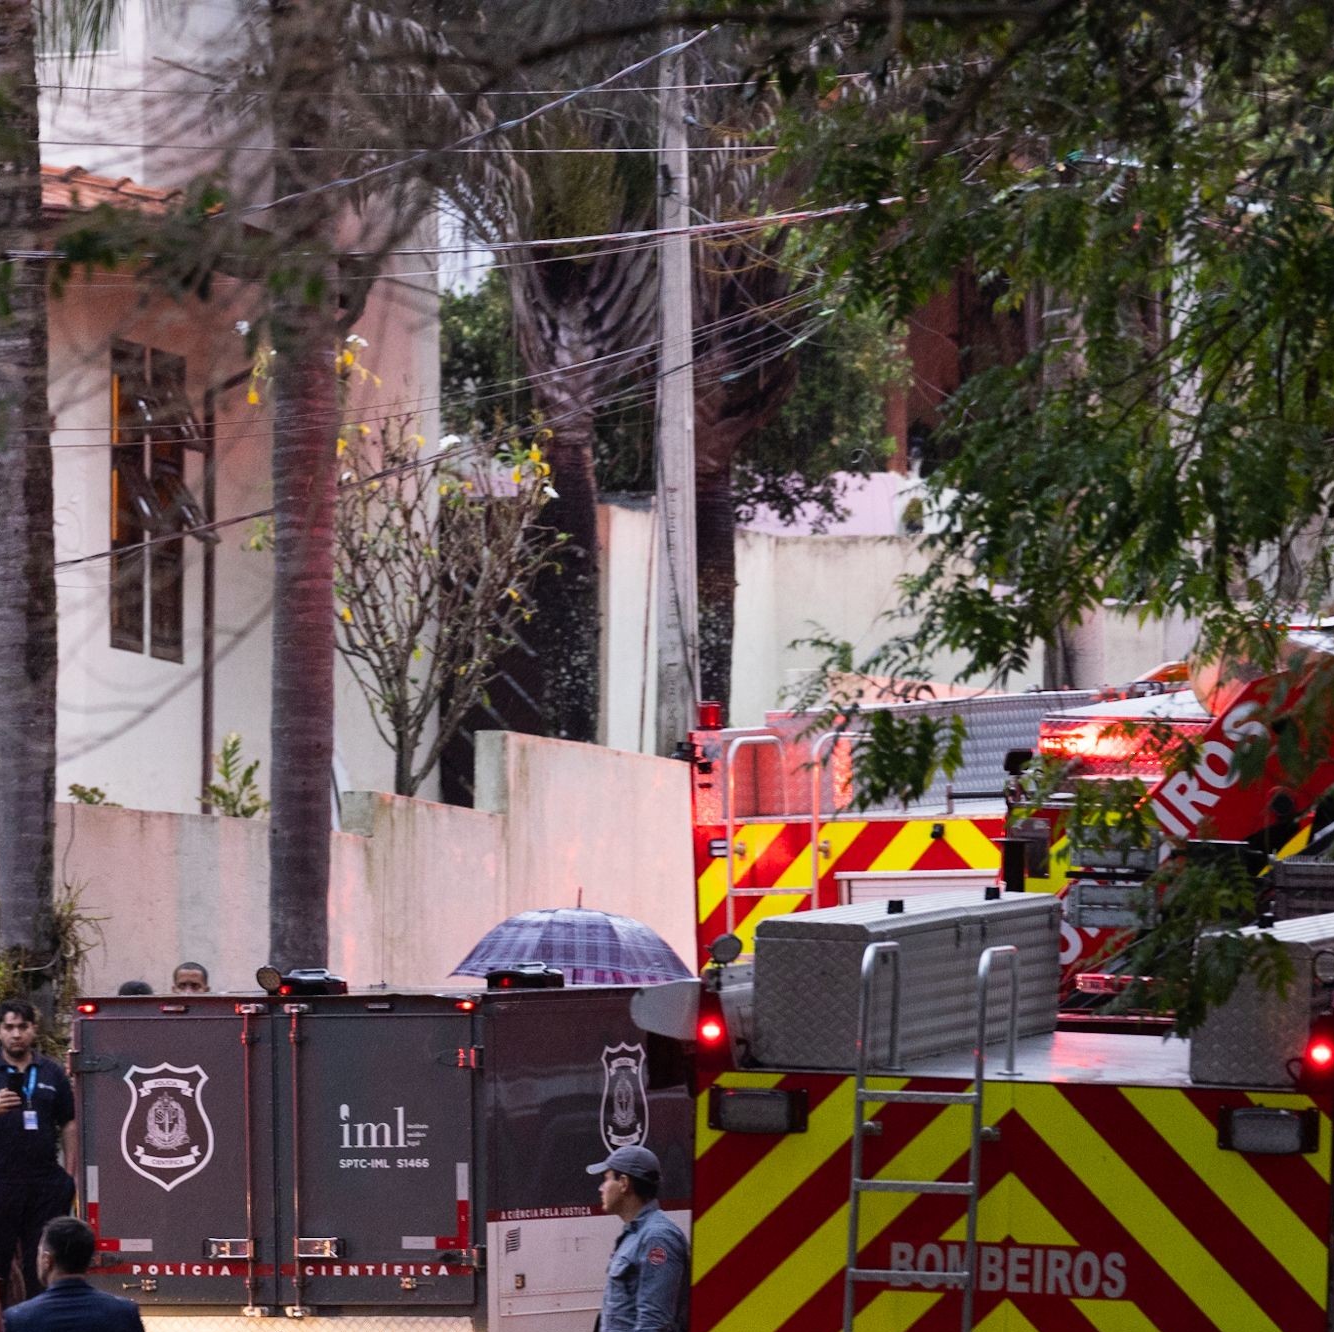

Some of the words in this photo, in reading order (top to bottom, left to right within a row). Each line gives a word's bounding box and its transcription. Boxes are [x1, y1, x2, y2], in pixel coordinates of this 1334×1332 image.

[339, 1104, 408, 1148] iml
[339, 1159, 391, 1169] SPTC-IML
[397, 1159, 430, 1169] S1466
[540, 1207, 560, 1217] PELA
[132, 1263, 232, 1276] POLÍCIA
[305, 1263, 449, 1277] CIENTÍFICA
